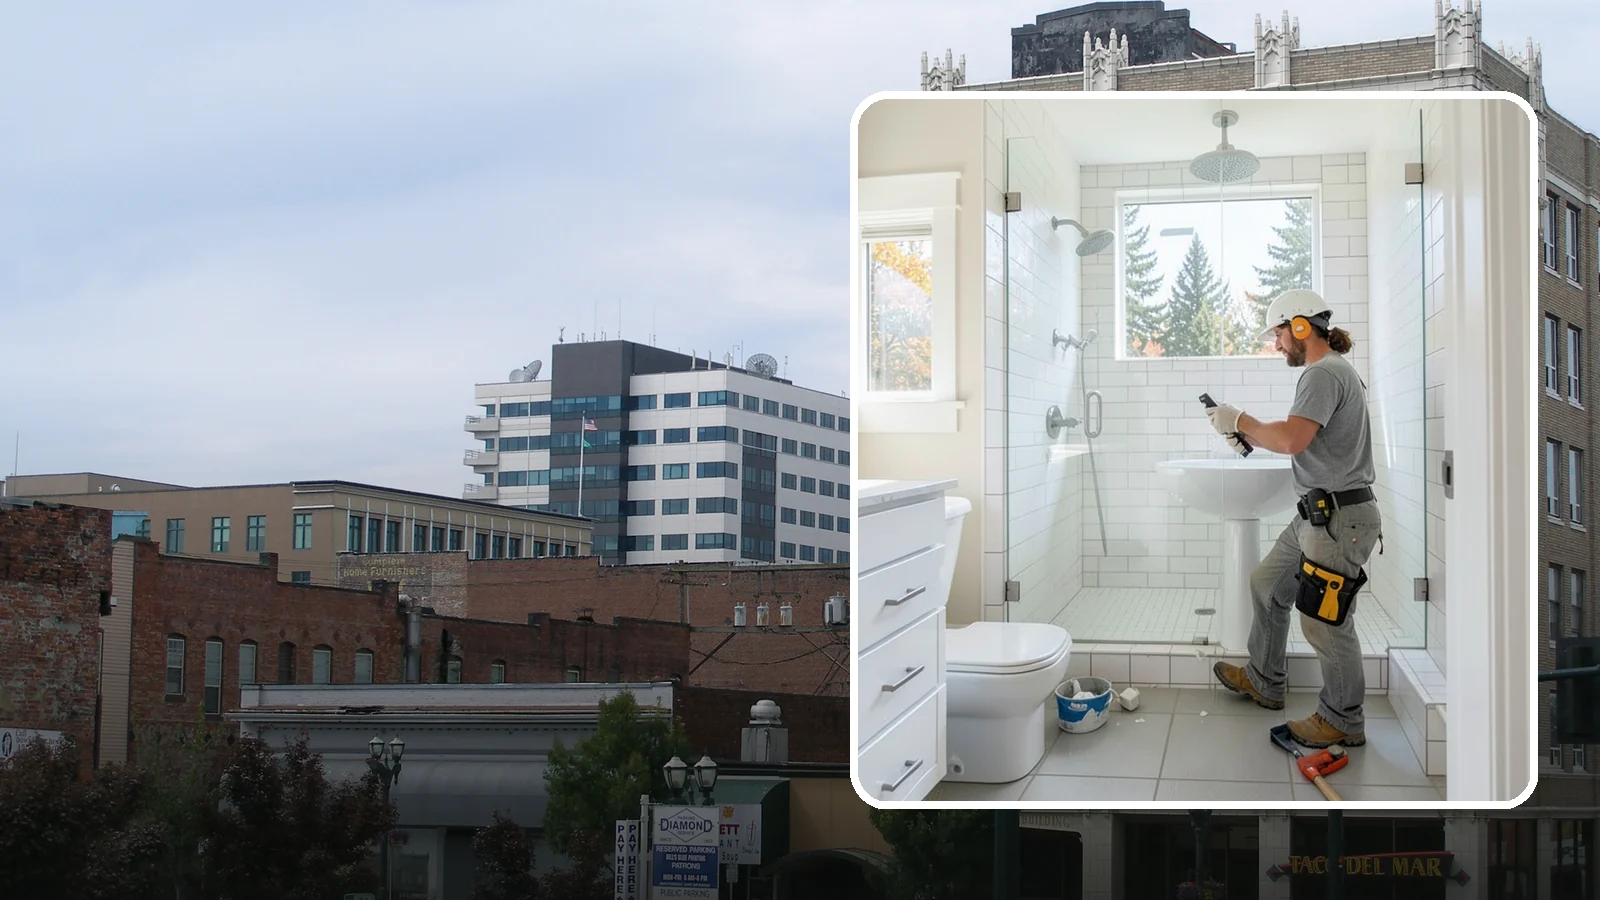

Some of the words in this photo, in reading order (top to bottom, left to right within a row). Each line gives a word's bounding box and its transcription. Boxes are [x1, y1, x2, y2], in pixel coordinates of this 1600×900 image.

[371, 566, 427, 576] Furnishers
[660, 818, 713, 832] DIAMOND
[1022, 815, 1069, 828] BUILDING
[617, 825, 625, 852] PAY
[628, 824, 636, 852] PAY
[656, 845, 688, 853] RESERVED
[689, 846, 716, 854] PARKING
[671, 862, 701, 870] PATRONS
[1345, 856, 1385, 875] DEL
[1392, 857, 1442, 877] MAR
[617, 856, 625, 893] HERE
[628, 856, 636, 893] HERE
[660, 888, 682, 897] PUBLIC
[684, 889, 710, 898] PARKING
